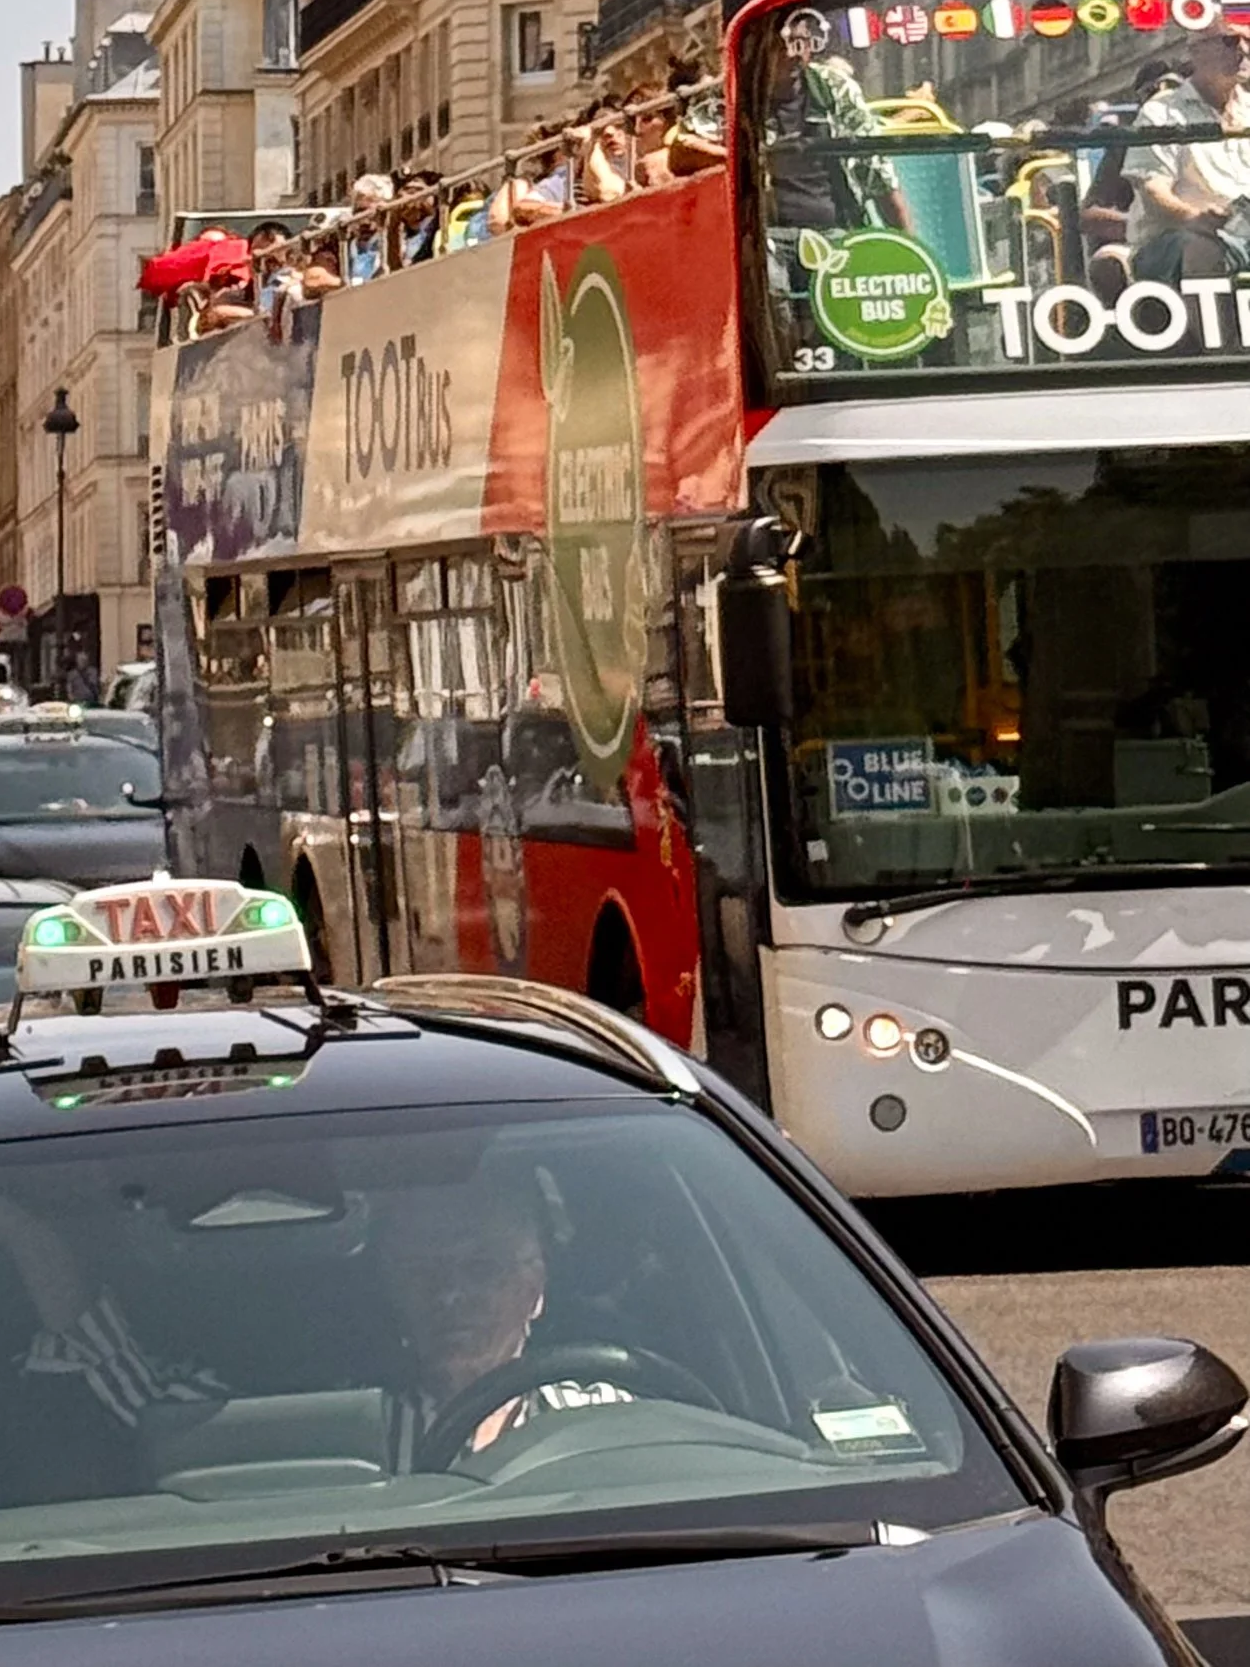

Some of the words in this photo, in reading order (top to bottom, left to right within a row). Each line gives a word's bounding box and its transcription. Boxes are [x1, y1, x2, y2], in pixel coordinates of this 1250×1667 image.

[830, 273, 932, 298] ELECTRIC
[861, 299, 906, 322] BUS
[794, 346, 835, 371] 33
[863, 750, 924, 772] BLUE
[873, 781, 926, 803] LINE
[95, 889, 219, 944] TAXI
[89, 946, 244, 982] PARISIEN
[1117, 977, 1250, 1030] PAR
